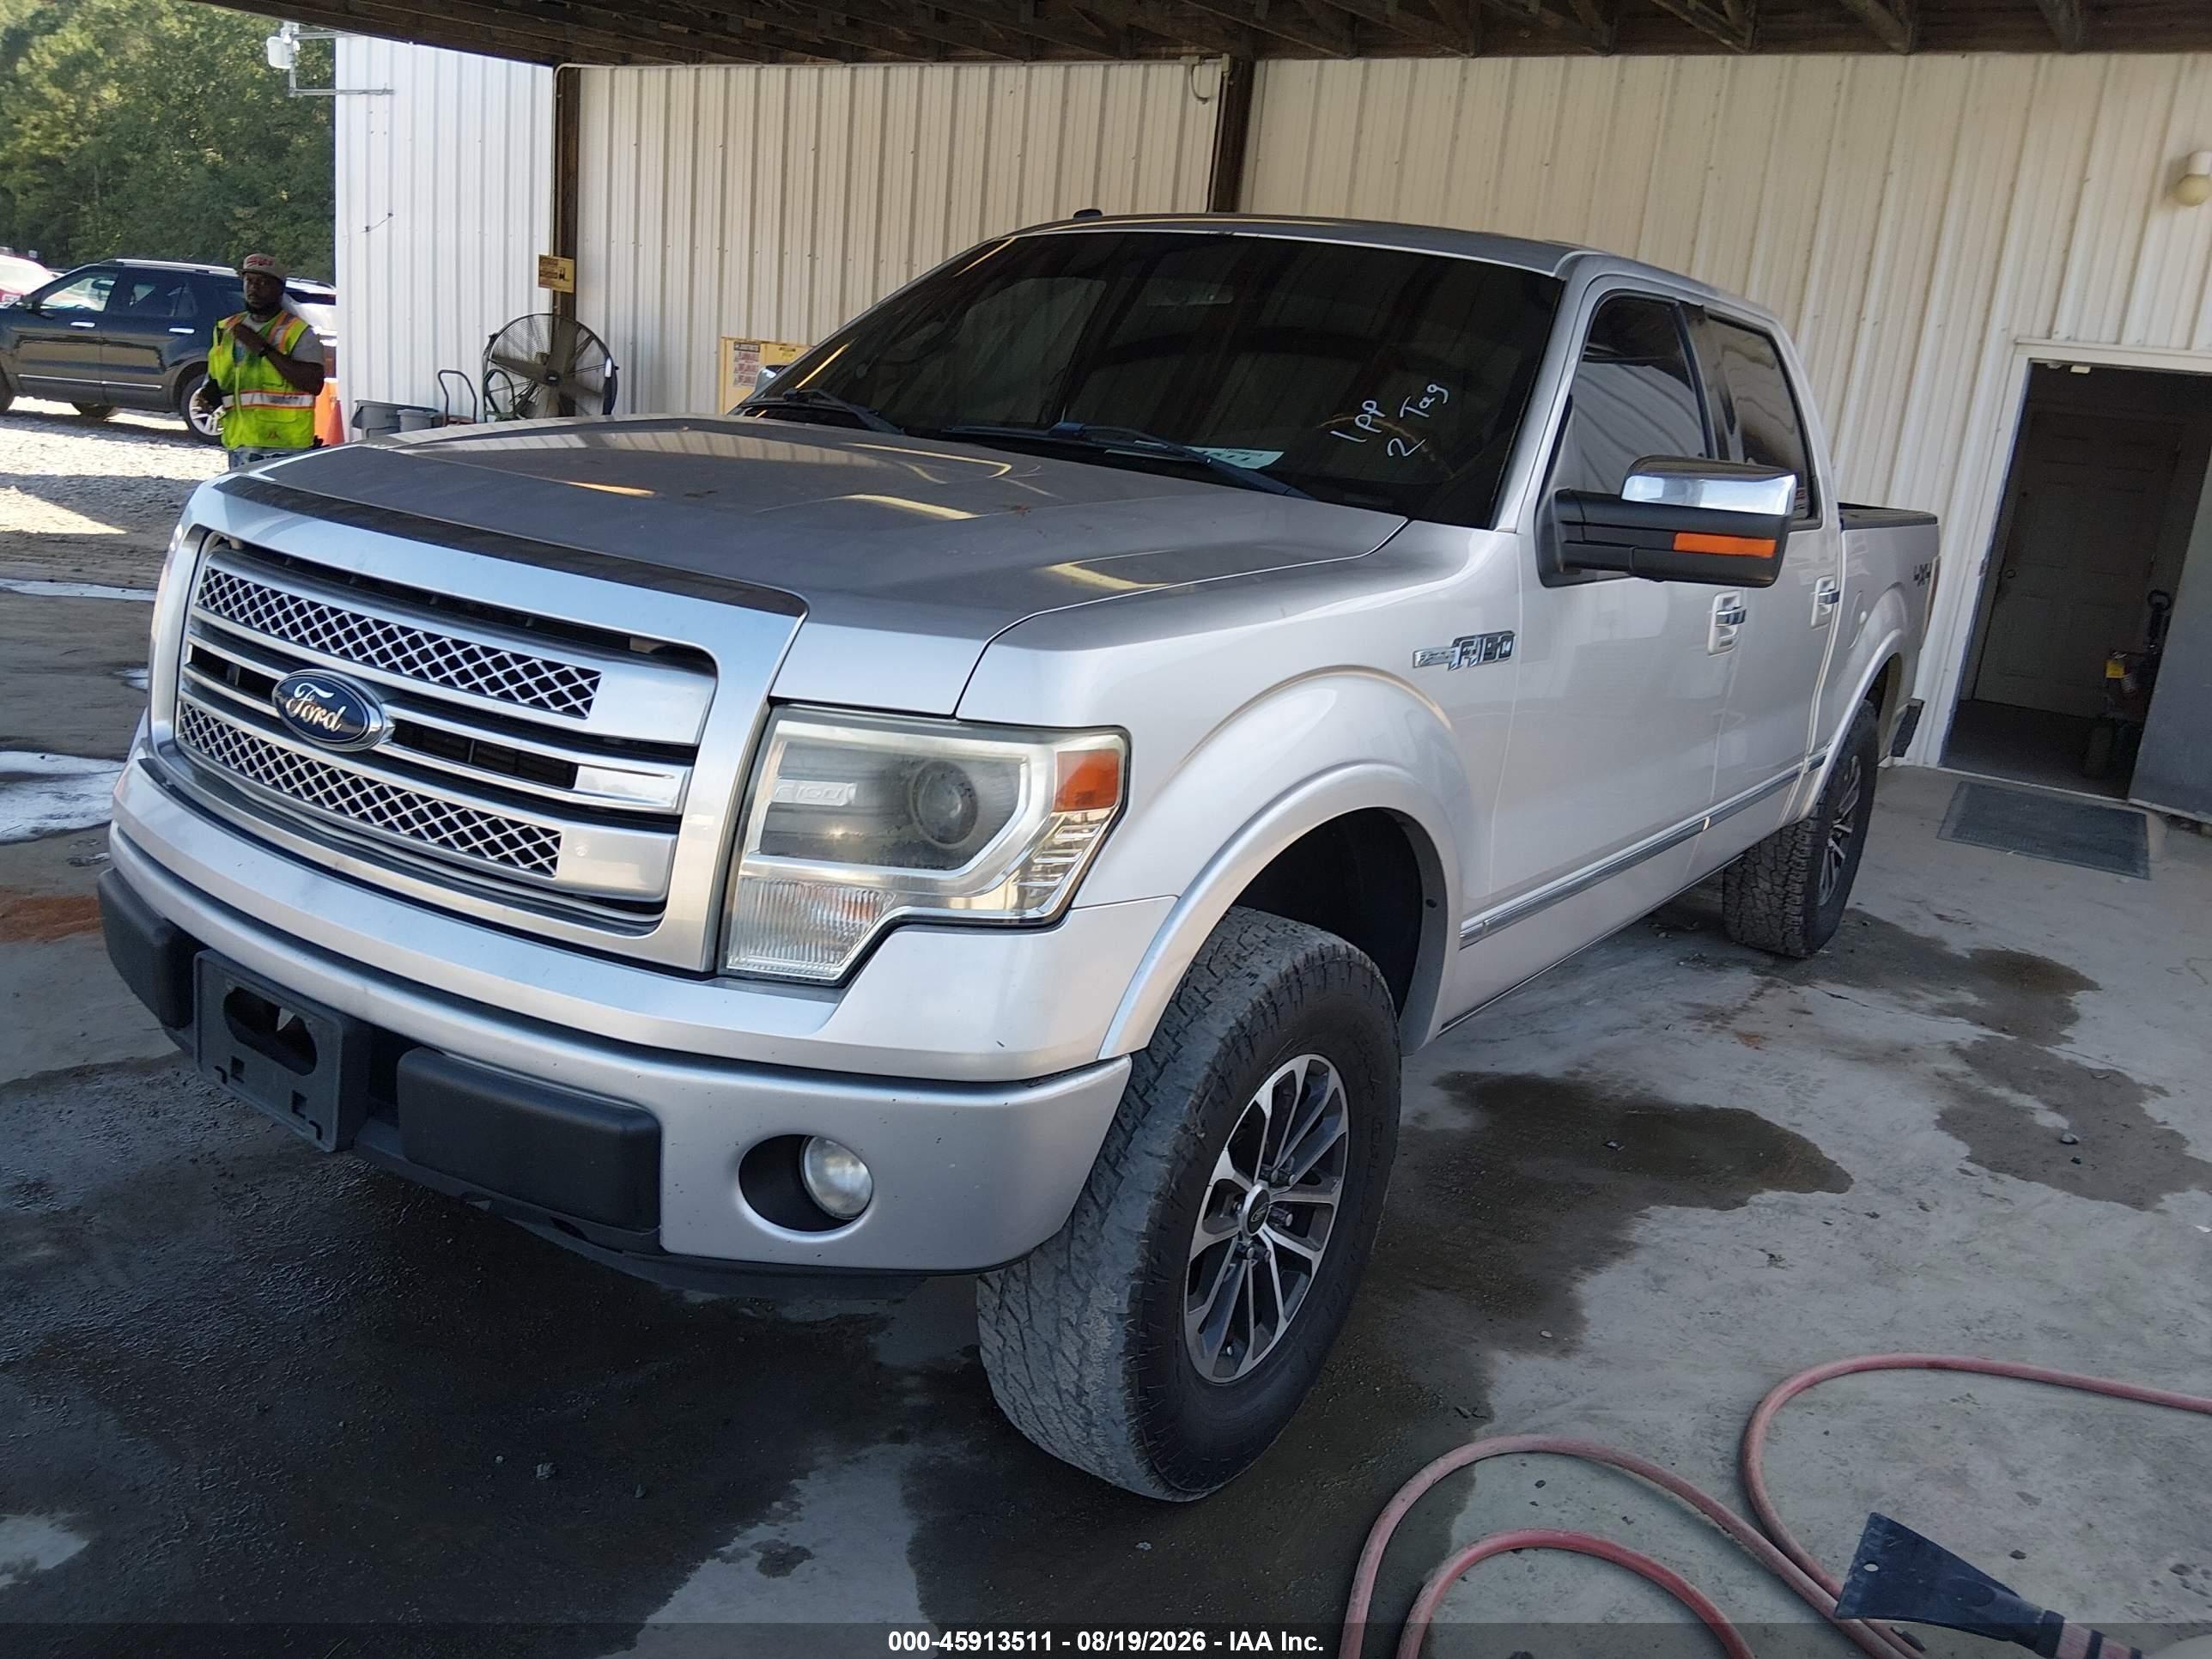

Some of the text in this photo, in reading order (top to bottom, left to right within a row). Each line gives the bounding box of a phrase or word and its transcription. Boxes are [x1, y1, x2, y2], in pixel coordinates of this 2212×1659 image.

[1387, 384, 1449, 457] 2 Tag
[285, 682, 347, 732] Ford
